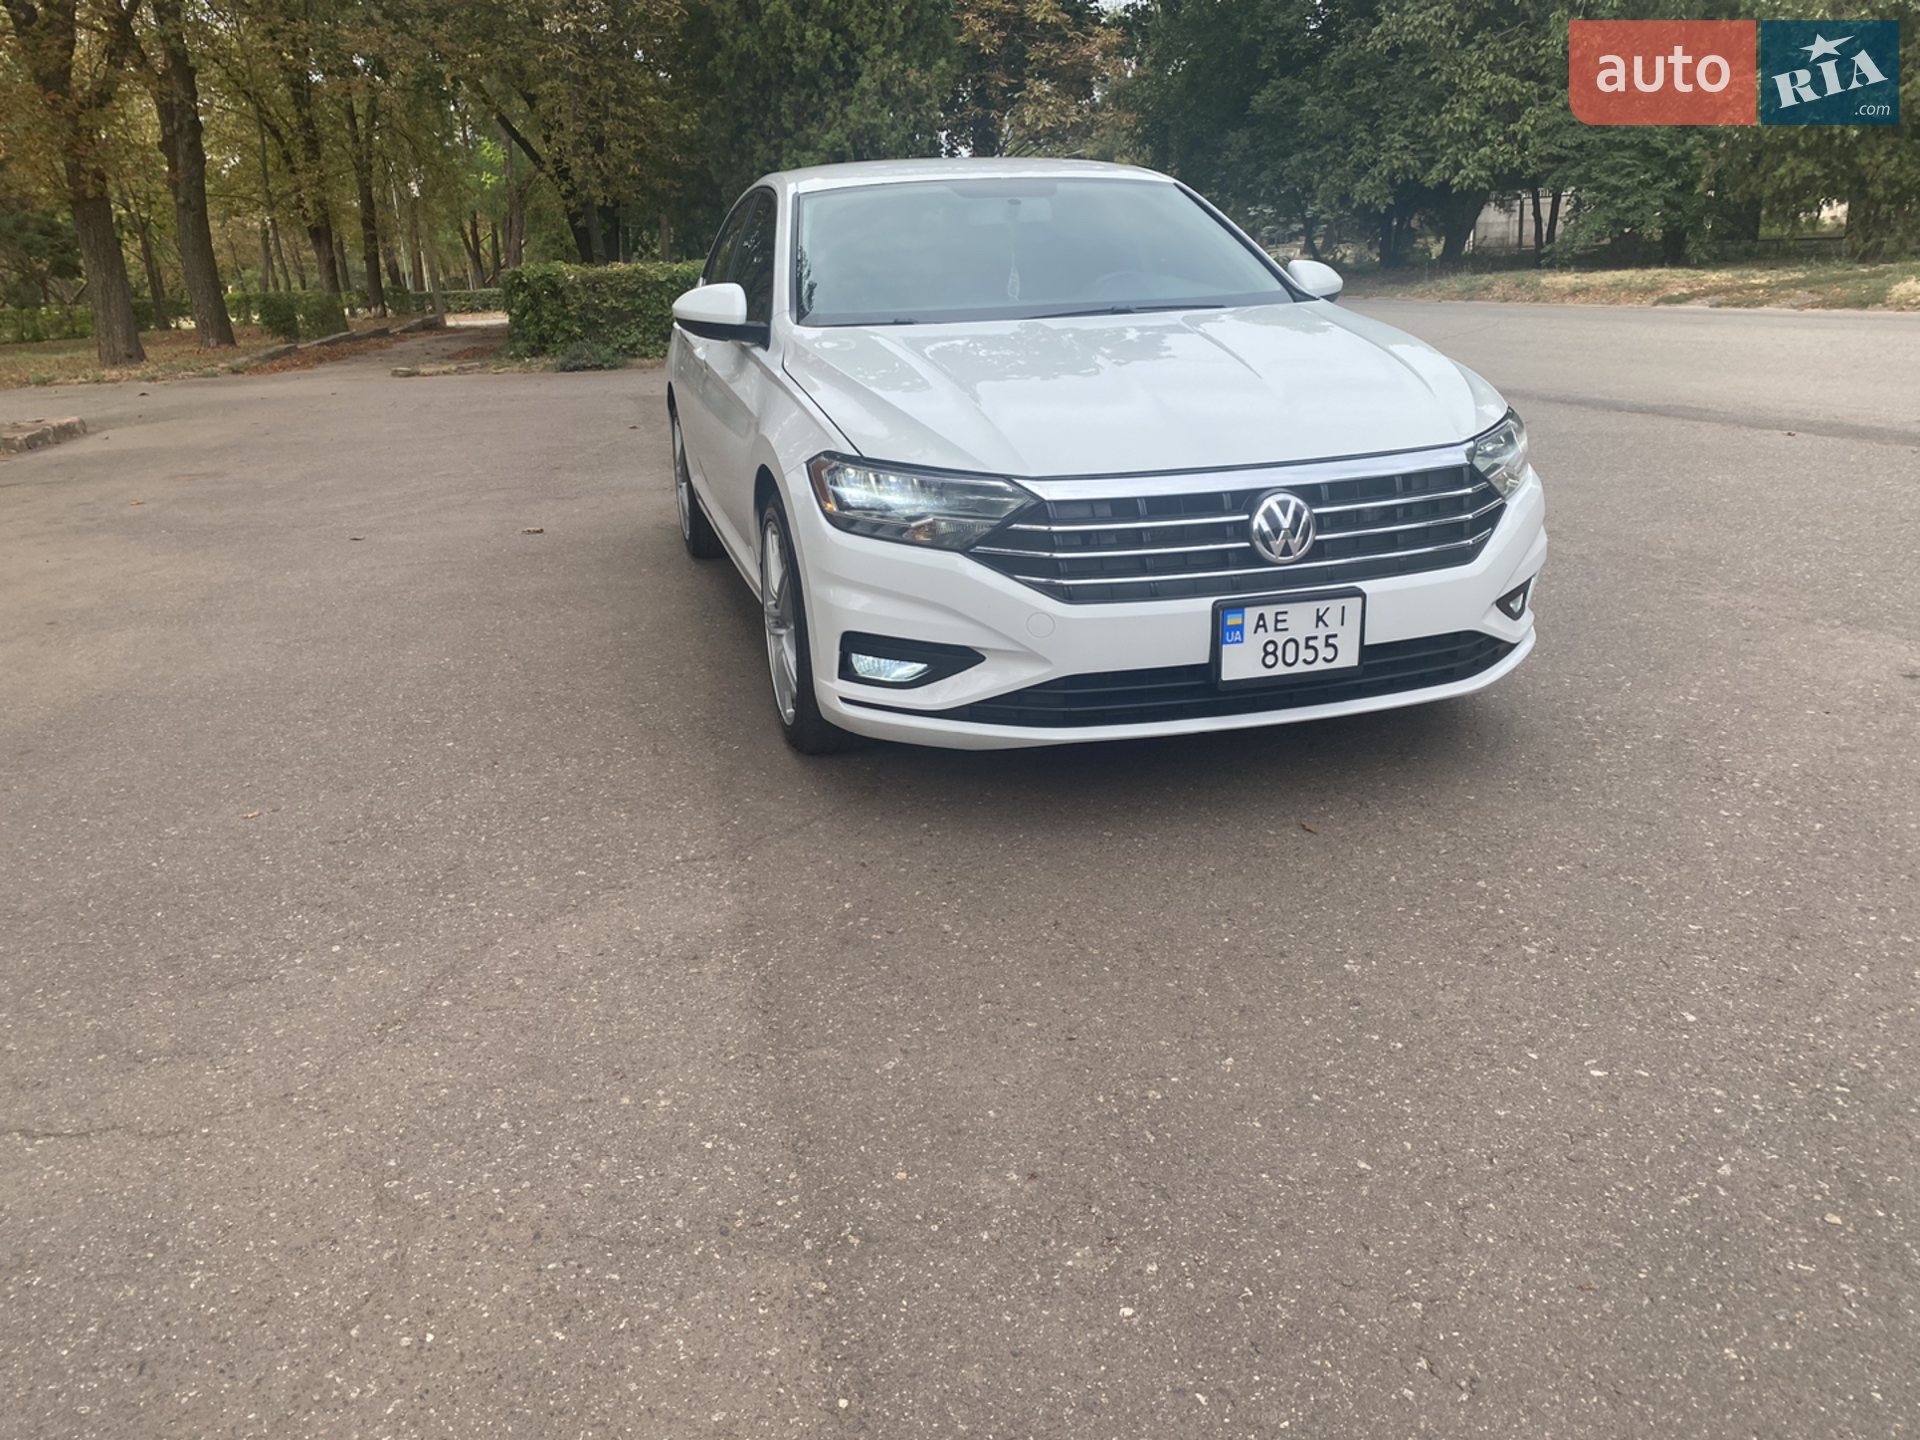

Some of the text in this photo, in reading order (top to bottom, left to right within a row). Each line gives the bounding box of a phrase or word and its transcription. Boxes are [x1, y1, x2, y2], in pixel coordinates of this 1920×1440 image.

[1252, 492, 1314, 562] VW
[1253, 605, 1346, 634] AE KI
[1226, 630, 1242, 643] UA
[1261, 633, 1339, 669] 8055
